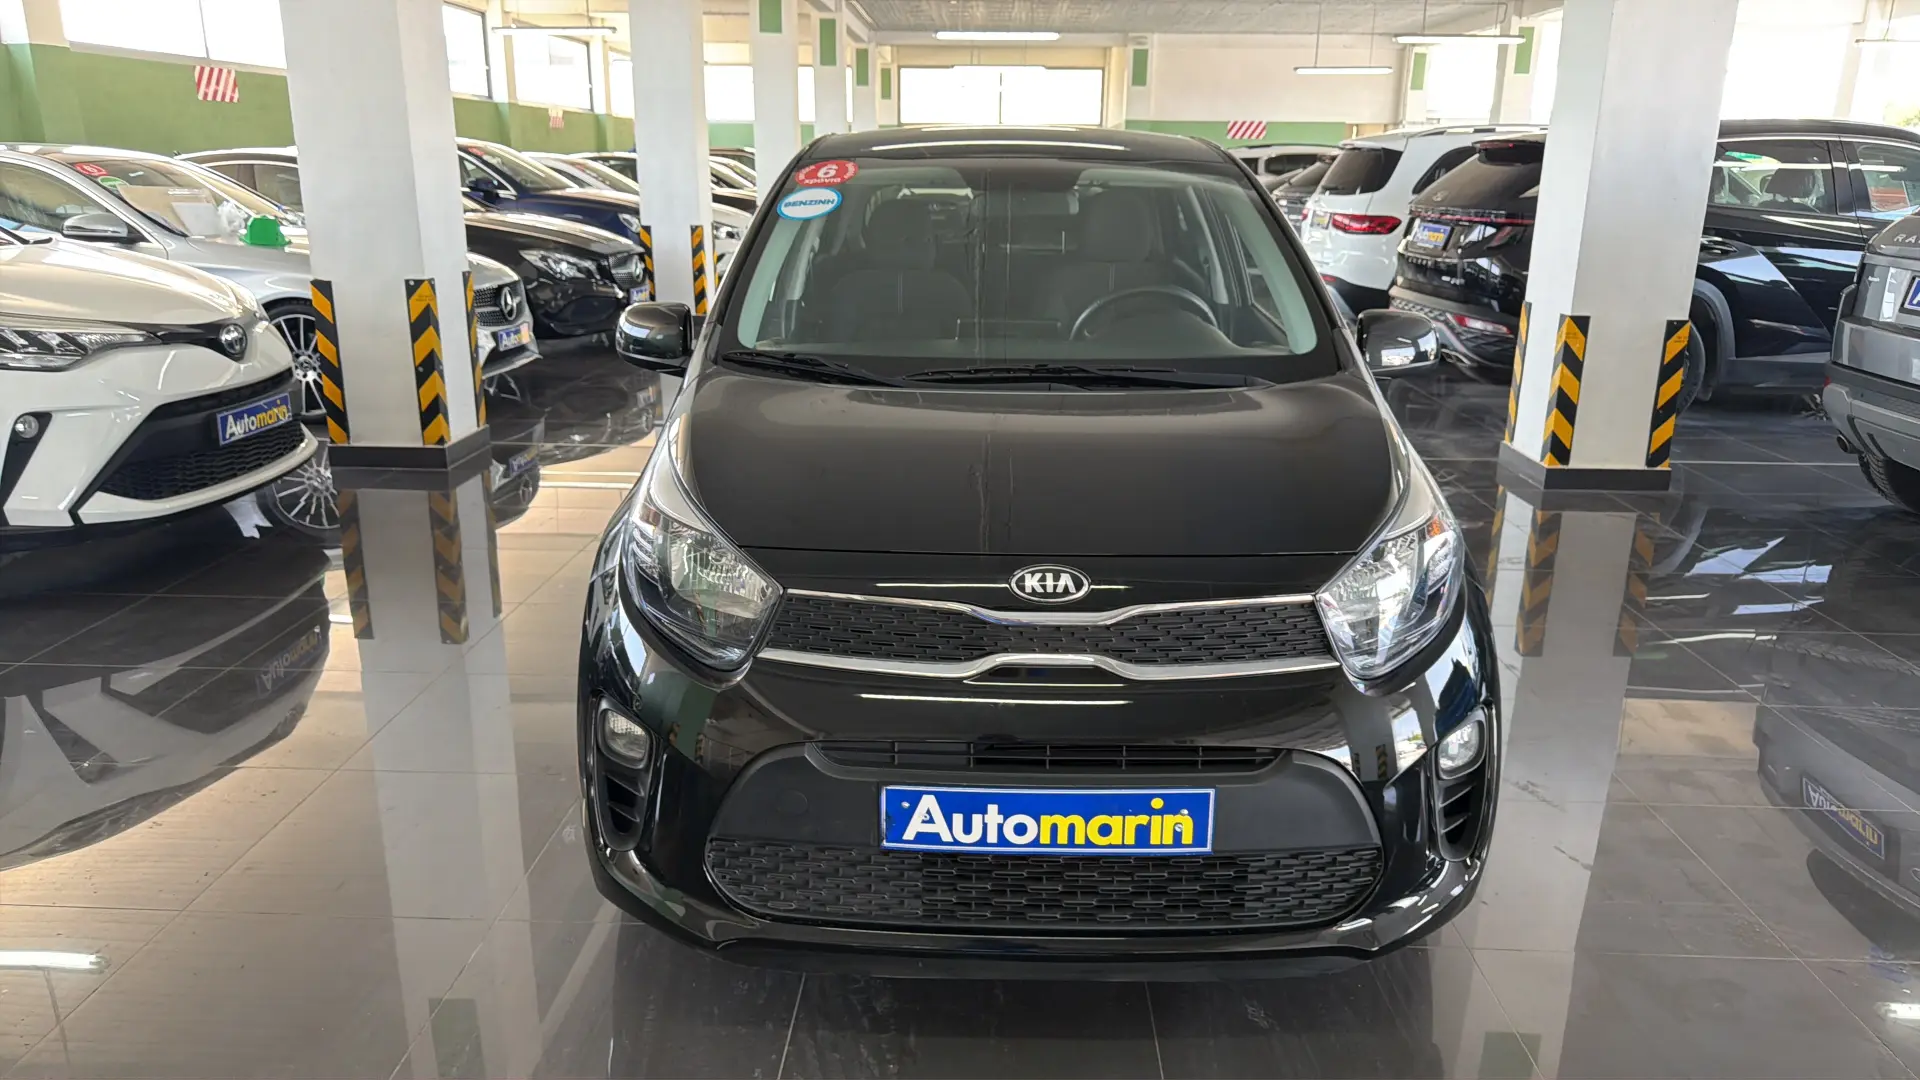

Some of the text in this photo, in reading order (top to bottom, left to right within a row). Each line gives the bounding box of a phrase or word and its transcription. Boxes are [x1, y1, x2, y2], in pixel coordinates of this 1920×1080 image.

[817, 163, 838, 178] 6
[1893, 234, 1920, 244] RA
[226, 400, 288, 439] Automarin
[1024, 572, 1077, 593] KIA
[902, 794, 1194, 846] Automarin
